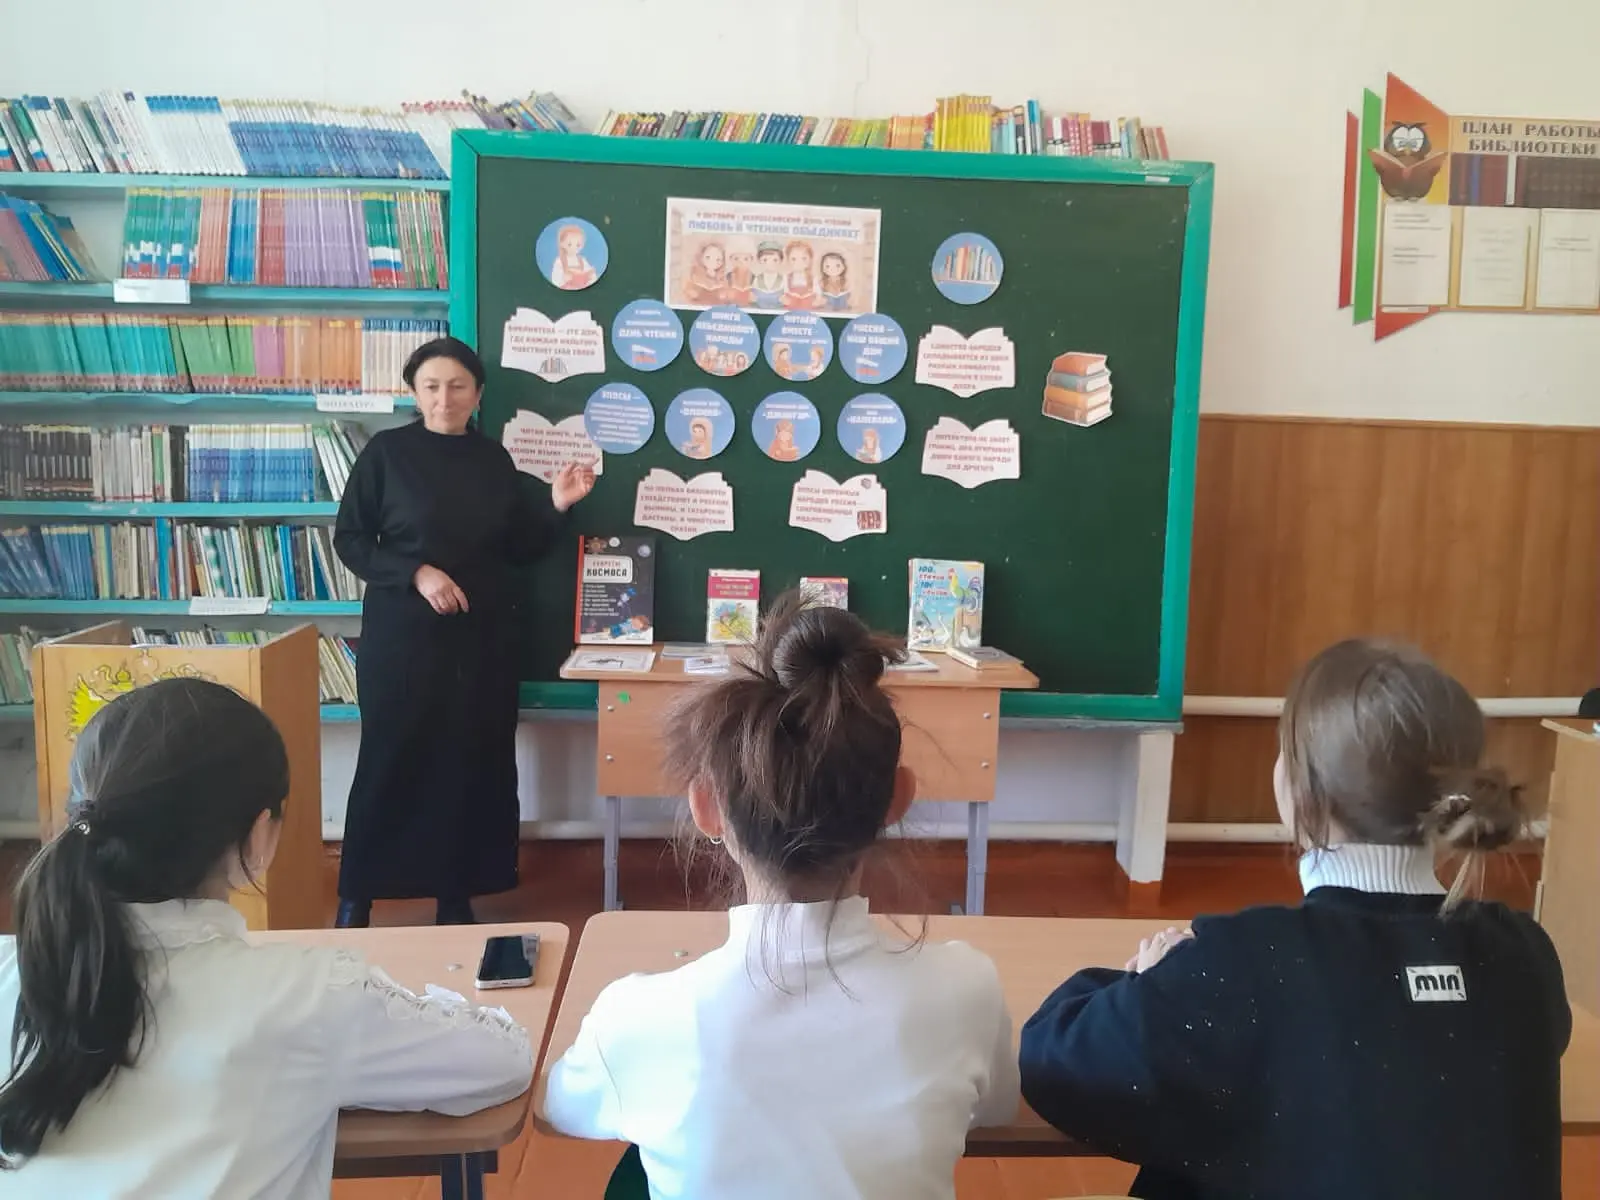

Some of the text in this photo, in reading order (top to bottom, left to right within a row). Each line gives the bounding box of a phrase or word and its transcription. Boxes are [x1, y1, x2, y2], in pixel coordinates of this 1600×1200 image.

[1462, 121, 1513, 136] ПЛАН
[1468, 139, 1597, 155] БИБЛИОТЕКИ
[688, 219, 734, 233] ЛЮБОВЬ
[745, 223, 789, 234] ЧТЕНИЮ
[619, 327, 677, 338] ДЕНЬ ЧТЕНИЯ
[586, 567, 628, 577] КОСМОСА
